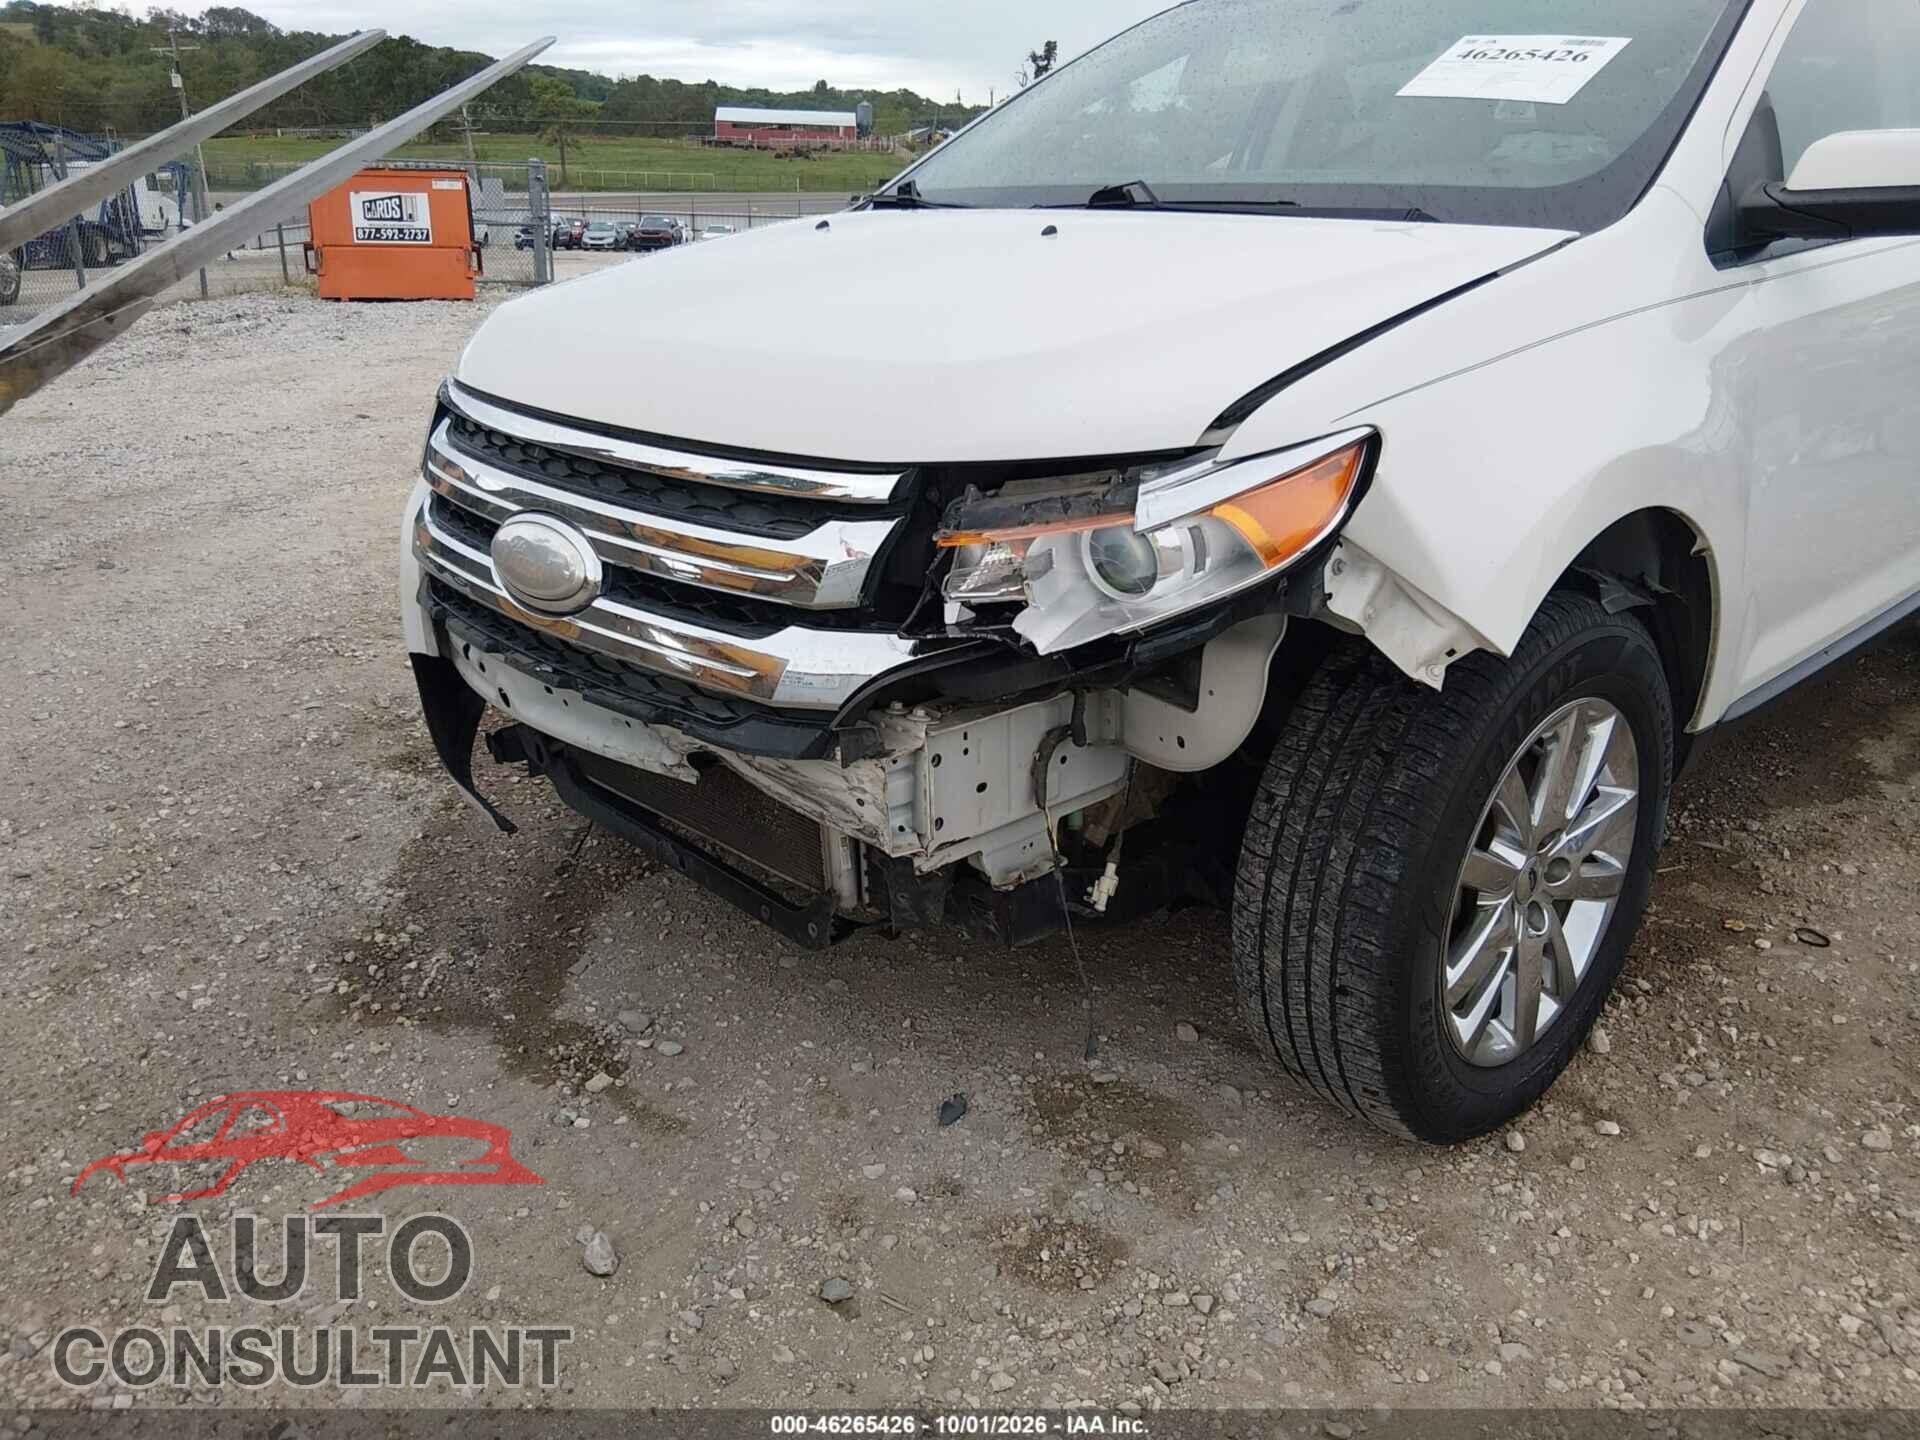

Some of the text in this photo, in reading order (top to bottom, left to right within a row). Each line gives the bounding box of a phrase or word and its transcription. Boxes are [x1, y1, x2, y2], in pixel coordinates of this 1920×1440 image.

[1456, 49, 1590, 63] 46265426
[364, 198, 401, 219] CARDS
[357, 229, 428, 241] 877-592-2737
